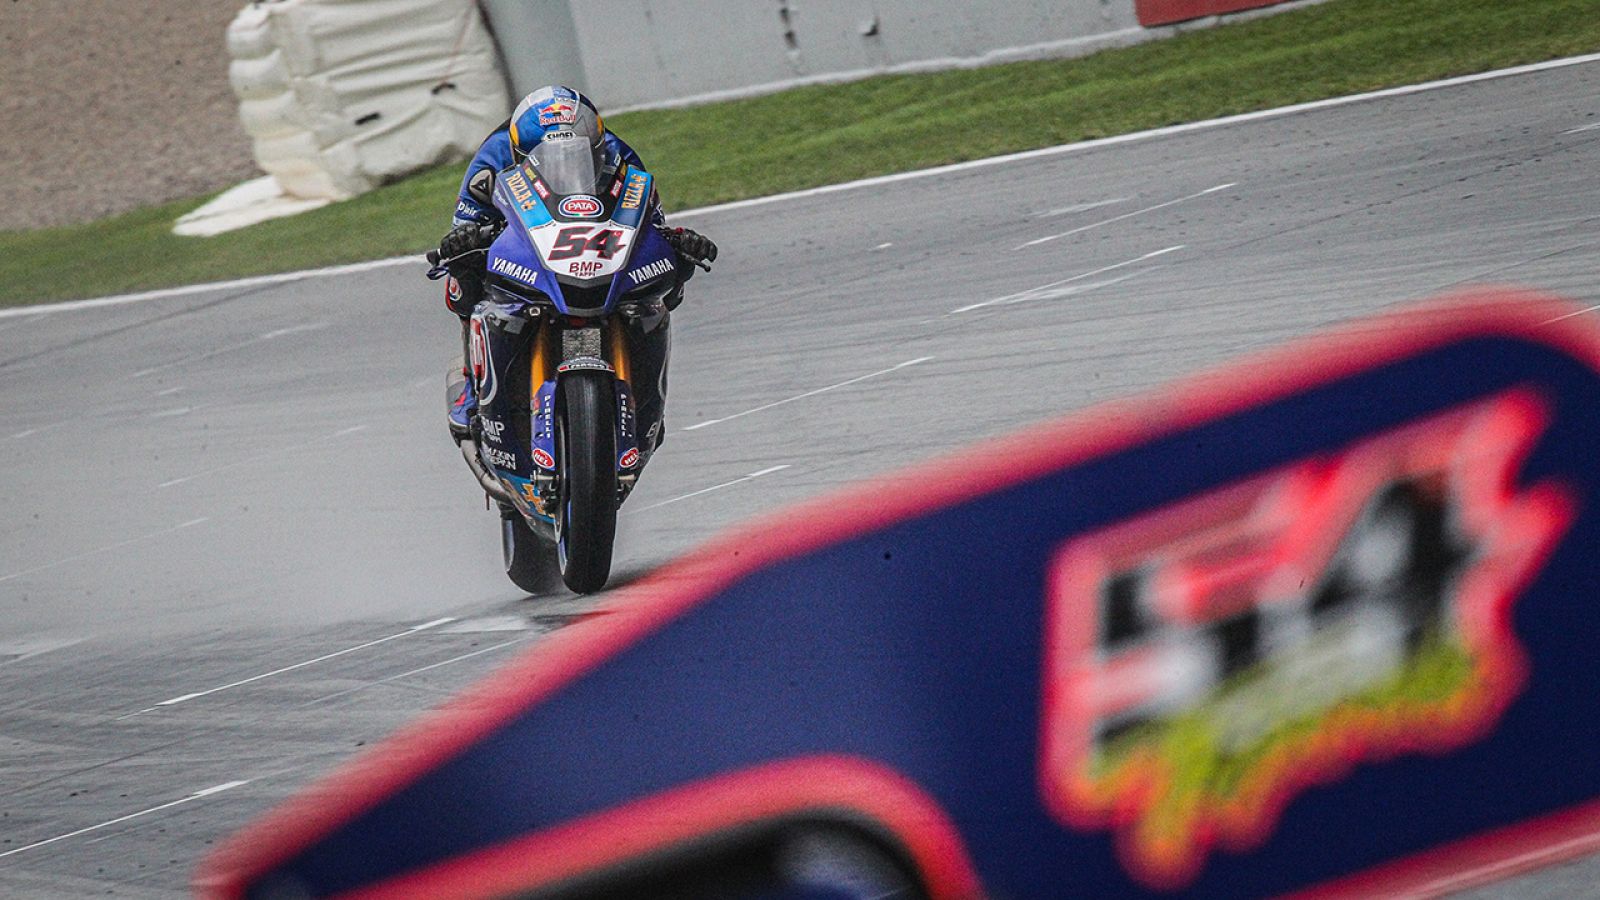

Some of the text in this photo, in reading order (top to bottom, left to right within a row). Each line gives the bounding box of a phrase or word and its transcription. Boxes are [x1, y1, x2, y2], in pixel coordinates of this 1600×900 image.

[567, 202, 594, 211] PATA
[548, 226, 626, 261] 54
[492, 257, 538, 285] YAMAHA
[569, 261, 603, 273] BMP
[628, 258, 674, 285] YAMAHA
[544, 394, 552, 439] PIRELLI
